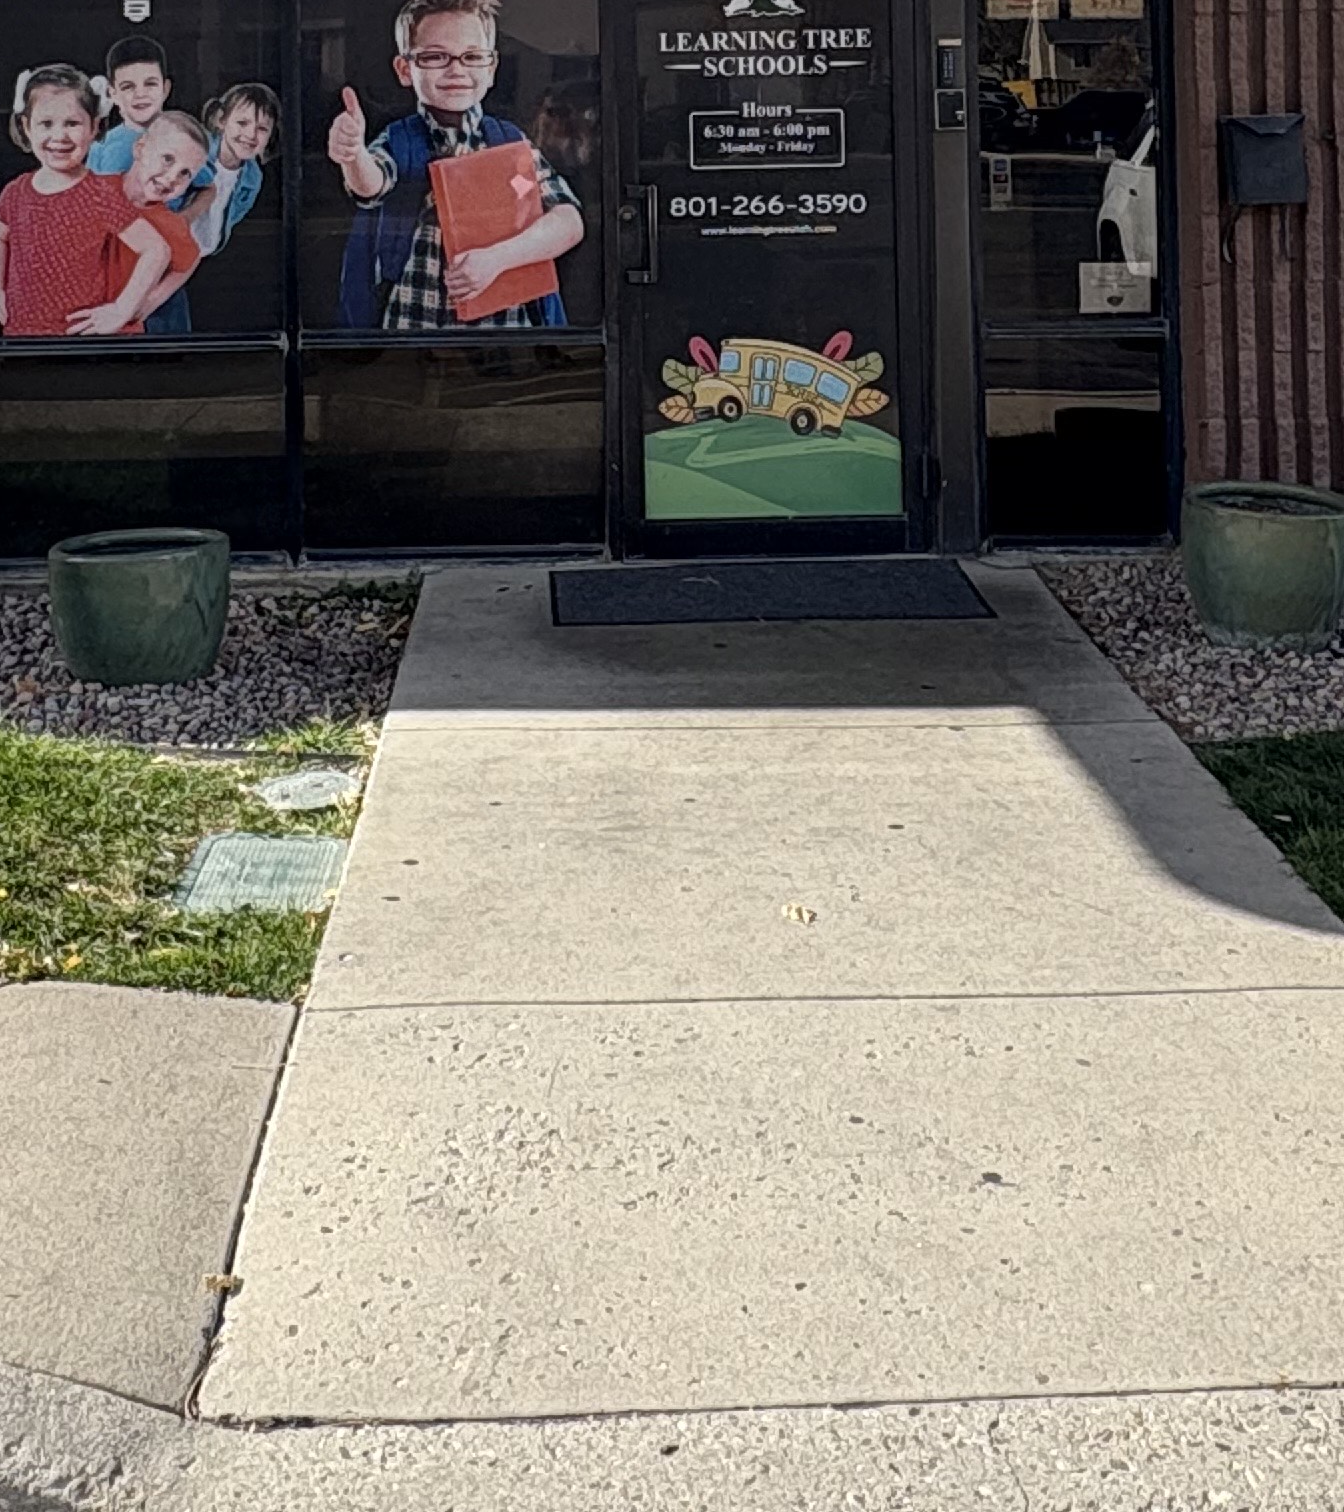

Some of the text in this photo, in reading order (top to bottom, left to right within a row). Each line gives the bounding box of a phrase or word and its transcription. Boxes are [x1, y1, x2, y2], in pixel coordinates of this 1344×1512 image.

[659, 27, 872, 52] LEARNING TREE
[704, 54, 828, 77] SCHOOLS
[742, 101, 792, 118] Hours
[703, 124, 735, 138] 6:30
[737, 126, 760, 138] am
[772, 122, 804, 136] 6:00
[806, 125, 831, 140] pm
[718, 142, 766, 154] Monday
[776, 140, 816, 154] Friday
[670, 193, 868, 217] 801-266-3590
